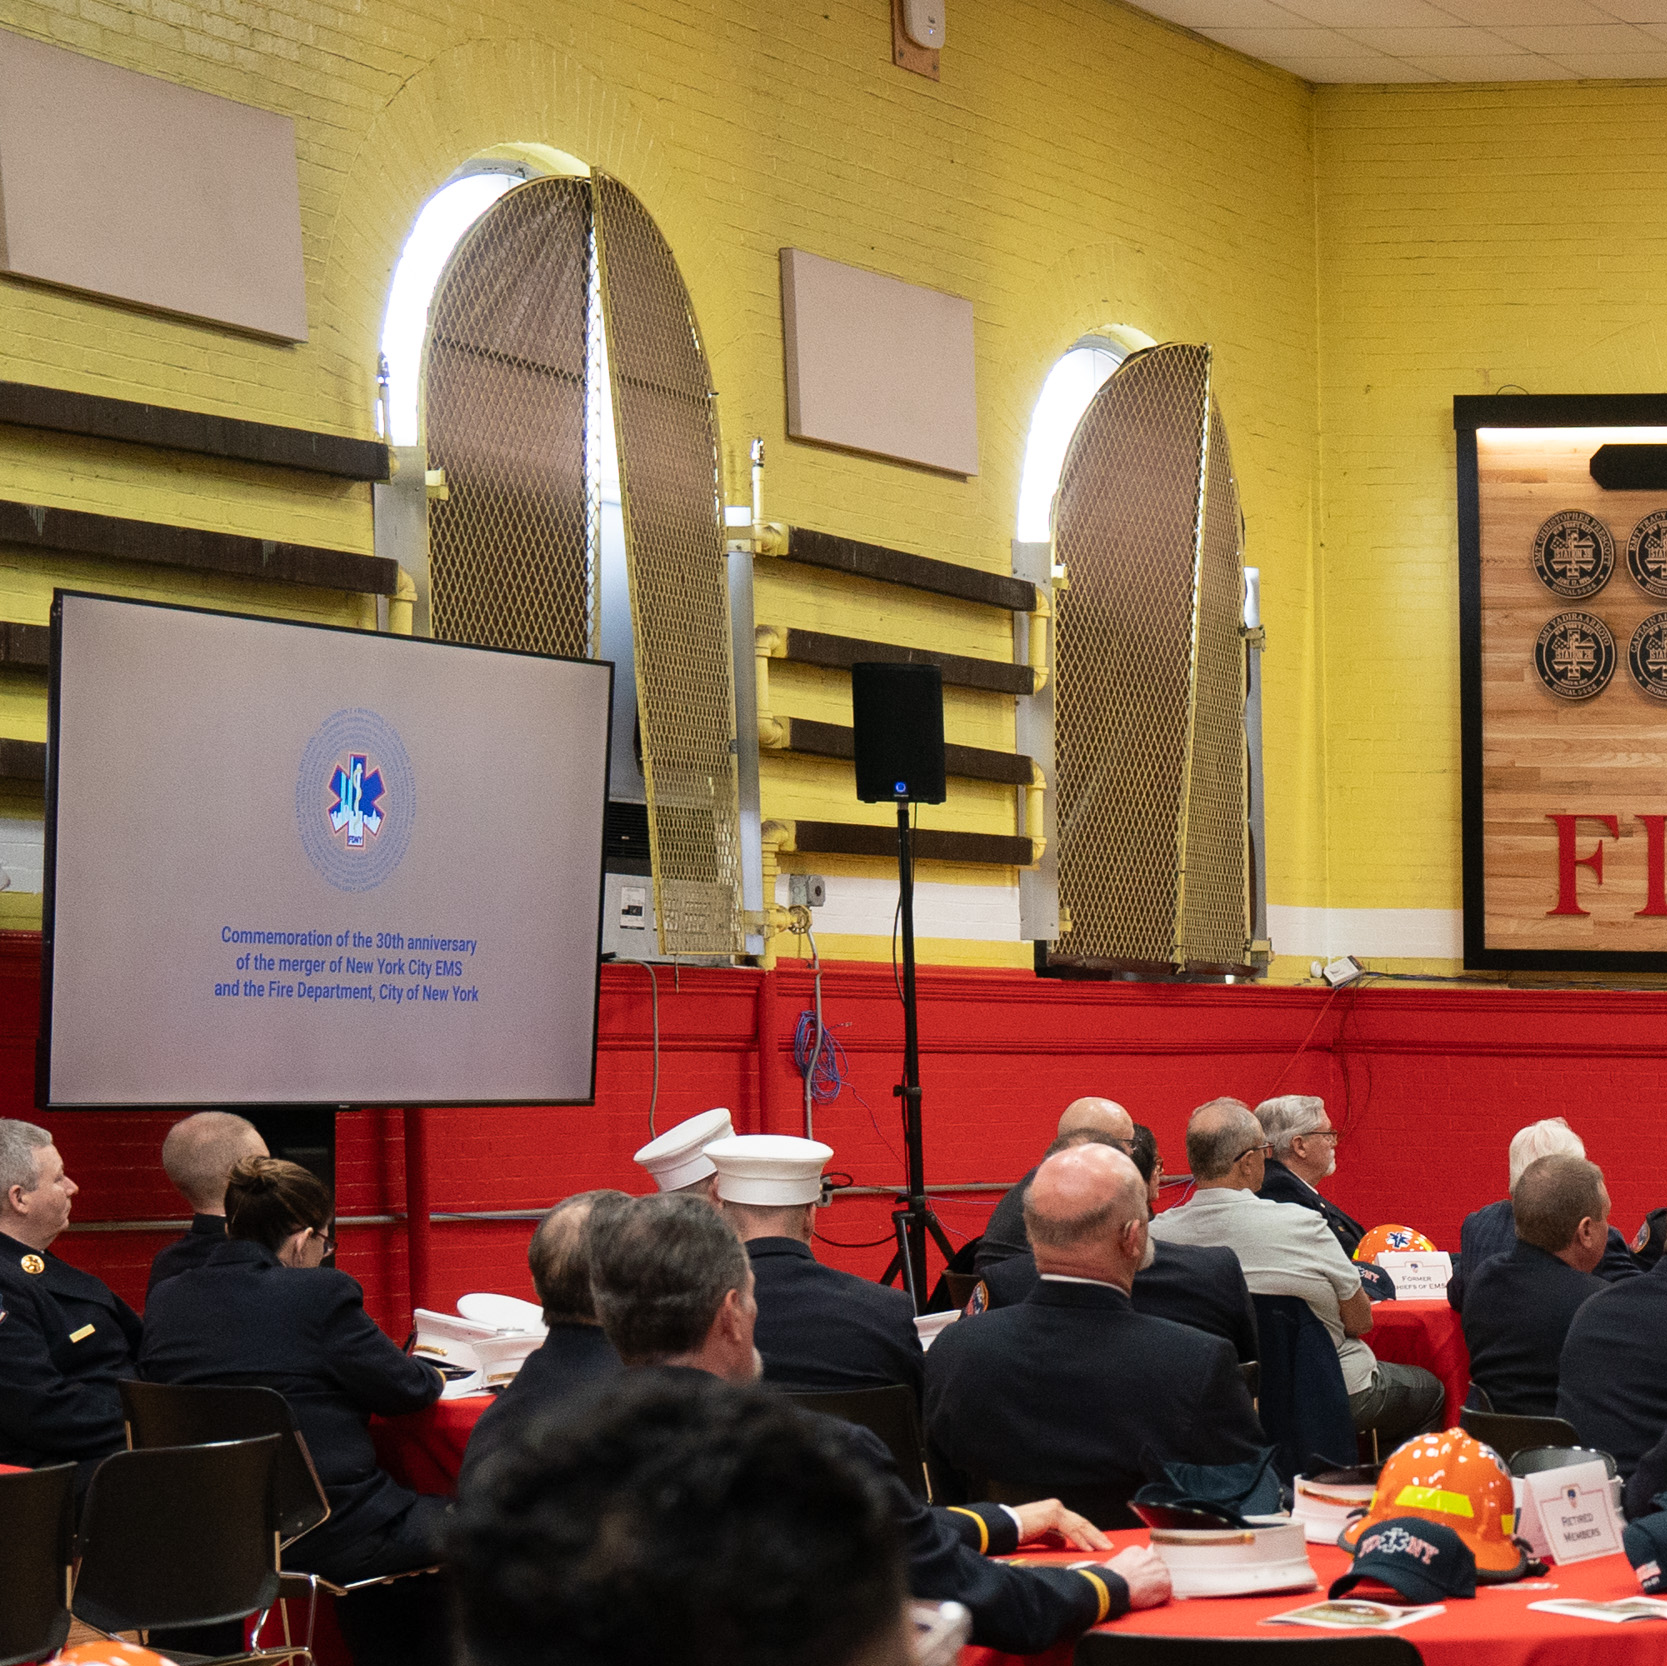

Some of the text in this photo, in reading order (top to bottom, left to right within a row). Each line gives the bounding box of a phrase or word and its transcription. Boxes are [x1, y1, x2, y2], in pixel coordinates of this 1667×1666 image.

[1536, 512, 1590, 547] CHRISTOPHER
[1590, 518, 1611, 567] PRESCOTT
[1628, 532, 1640, 551] EMT
[1639, 513, 1667, 533] TRACY
[1538, 613, 1610, 647] EMT YADIRA ARROYO
[1630, 615, 1657, 653] CAPTAIN
[221, 926, 477, 956] Commemoration of the 30th anniversary
[236, 953, 462, 979] of the merger of New York City EMS
[214, 979, 479, 1004] and the Fire Department, City of New York
[1561, 1512, 1594, 1528] RETIRED
[1563, 1527, 1601, 1543] MEMBERS
